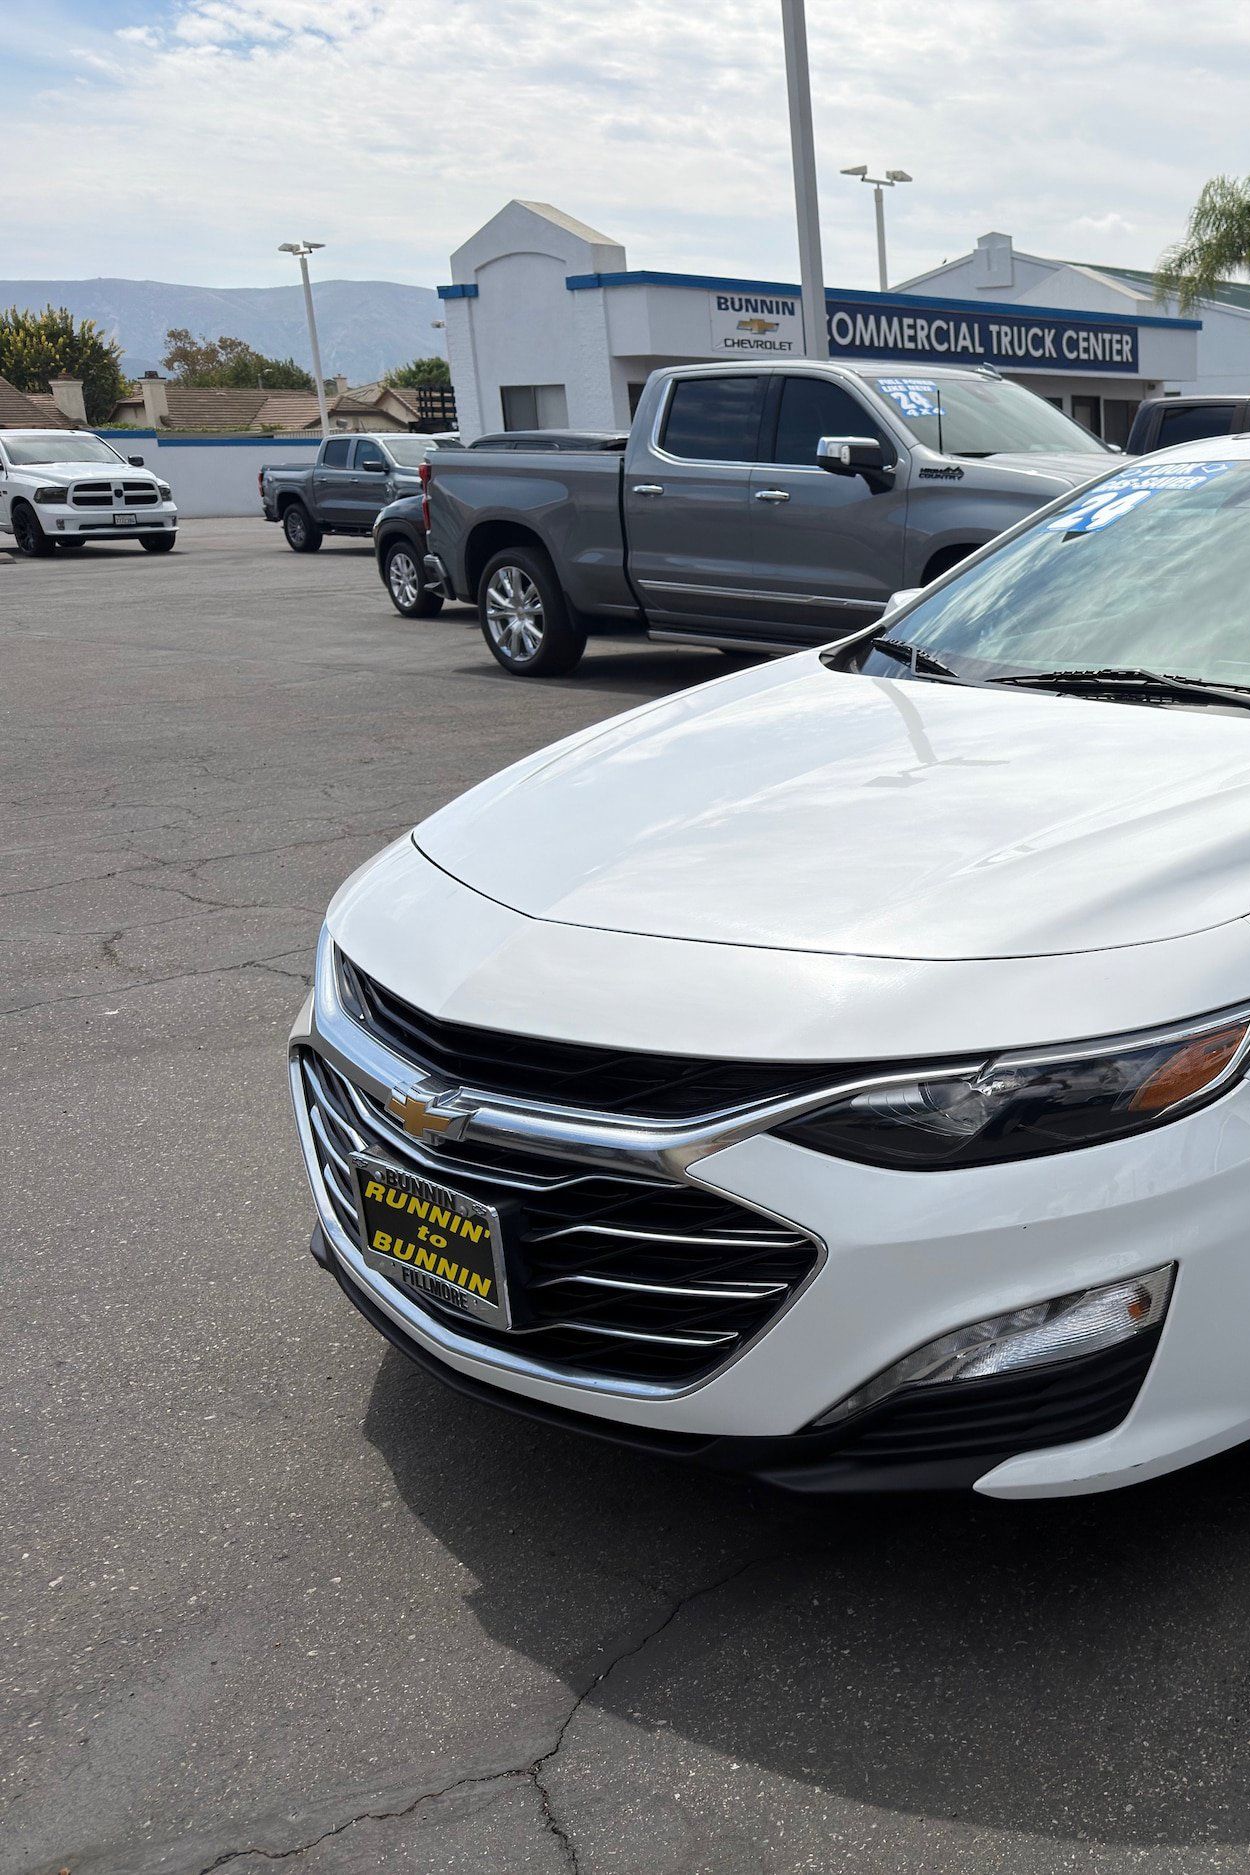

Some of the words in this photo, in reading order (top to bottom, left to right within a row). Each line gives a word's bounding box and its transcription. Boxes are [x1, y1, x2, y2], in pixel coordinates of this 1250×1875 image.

[716, 296, 796, 316] BUNNIN
[723, 338, 793, 351] CHEVROLET
[826, 311, 984, 354] OMMERCIAL
[989, 324, 1057, 358] TRUCK
[1061, 330, 1133, 362] CENTER
[890, 391, 933, 409] 24
[1047, 490, 1152, 531] 24
[385, 1166, 457, 1210] BUNNIN
[364, 1180, 491, 1244] RUNNIN'
[417, 1225, 448, 1249] to
[372, 1230, 492, 1298] BUNNIN
[402, 1265, 469, 1309] FILLMORE
